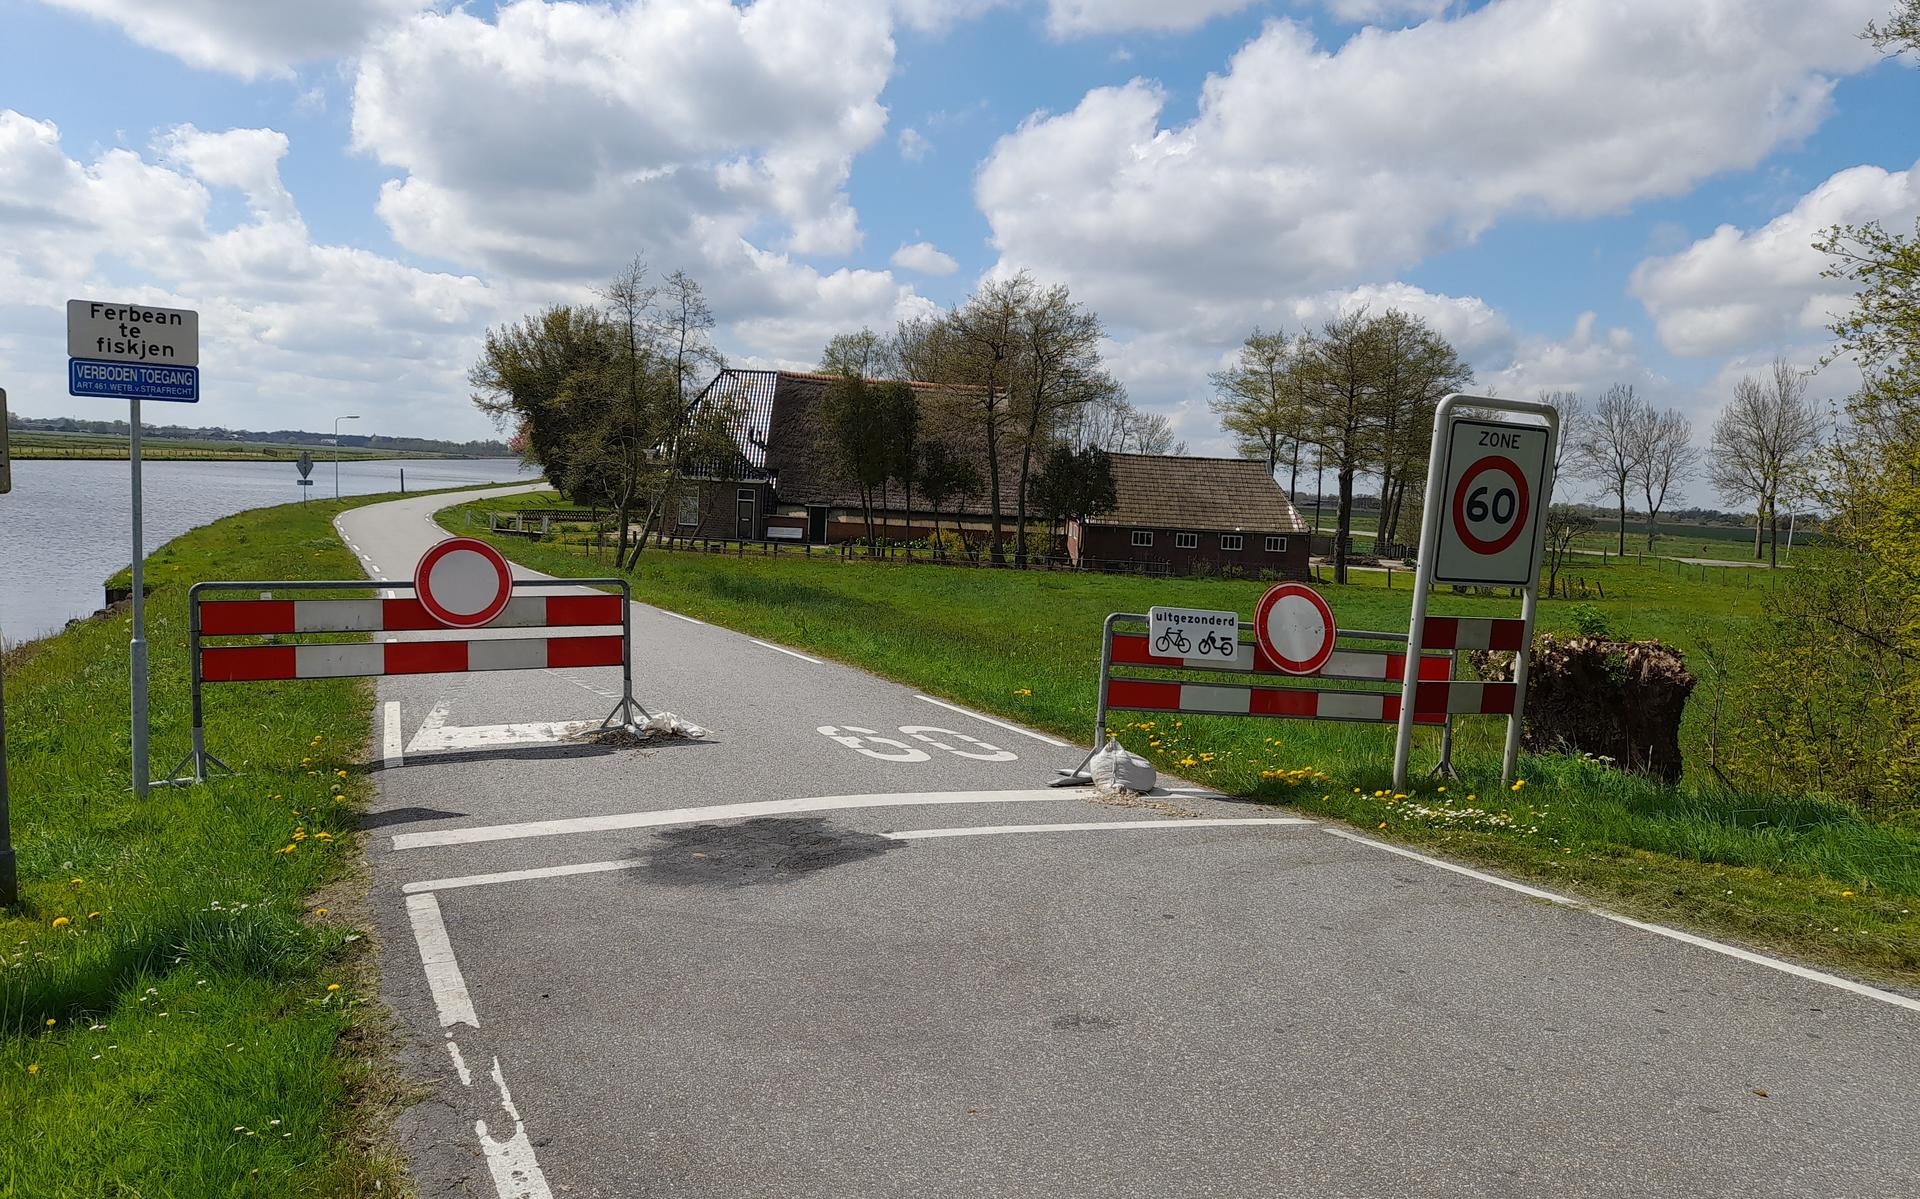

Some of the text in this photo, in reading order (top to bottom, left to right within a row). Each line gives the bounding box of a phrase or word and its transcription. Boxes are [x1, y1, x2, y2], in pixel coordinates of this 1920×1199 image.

[90, 303, 182, 326] Ferbean
[119, 322, 141, 339] te
[96, 337, 174, 360] fiskjen
[76, 365, 193, 386] VERBODEN TOEGANG
[1478, 430, 1521, 449] ZONE
[1466, 486, 1516, 525] 60
[1156, 611, 1235, 627] uitgezonderd
[816, 724, 1019, 763] 60
